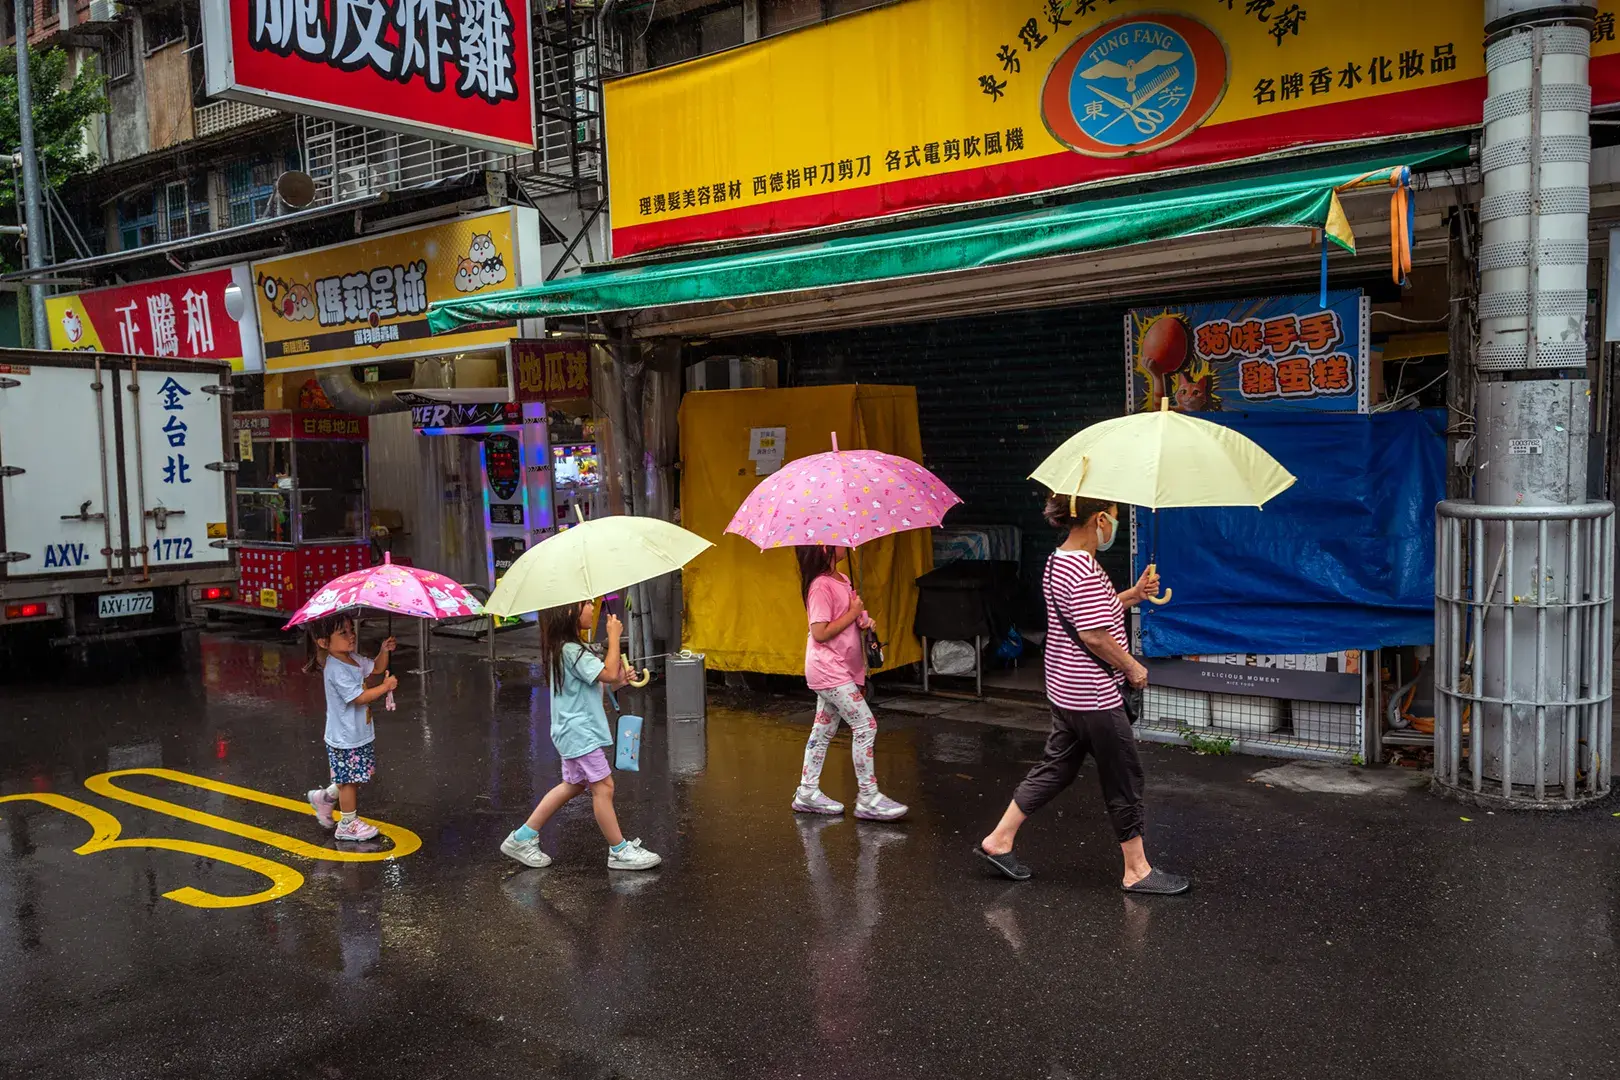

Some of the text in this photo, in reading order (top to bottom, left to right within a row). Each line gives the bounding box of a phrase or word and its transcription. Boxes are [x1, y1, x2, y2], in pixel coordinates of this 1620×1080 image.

[1089, 29, 1173, 63] TUNG FANG
[1081, 85, 1186, 122] 東 芳
[639, 178, 742, 216] 理燙髮美容器材
[752, 154, 871, 197] 西德指甲刀剪刀
[884, 126, 1025, 173] 各式電剪吹風機
[1252, 42, 1458, 106] 名牌香水化妝品
[316, 261, 427, 326] 瑪莉星球
[115, 287, 215, 357] 正騰和
[1196, 313, 1337, 356] 貓咪手手
[518, 351, 590, 393] 地瓜球
[1241, 354, 1349, 394] 雞蛋糕
[157, 376, 192, 484] 金台北
[303, 418, 360, 434] 甘梅地瓜
[44, 537, 194, 568] AXV- 1772
[100, 596, 153, 615] AXV-1772
[1201, 671, 1281, 684] DELICIOUS MOMENT
